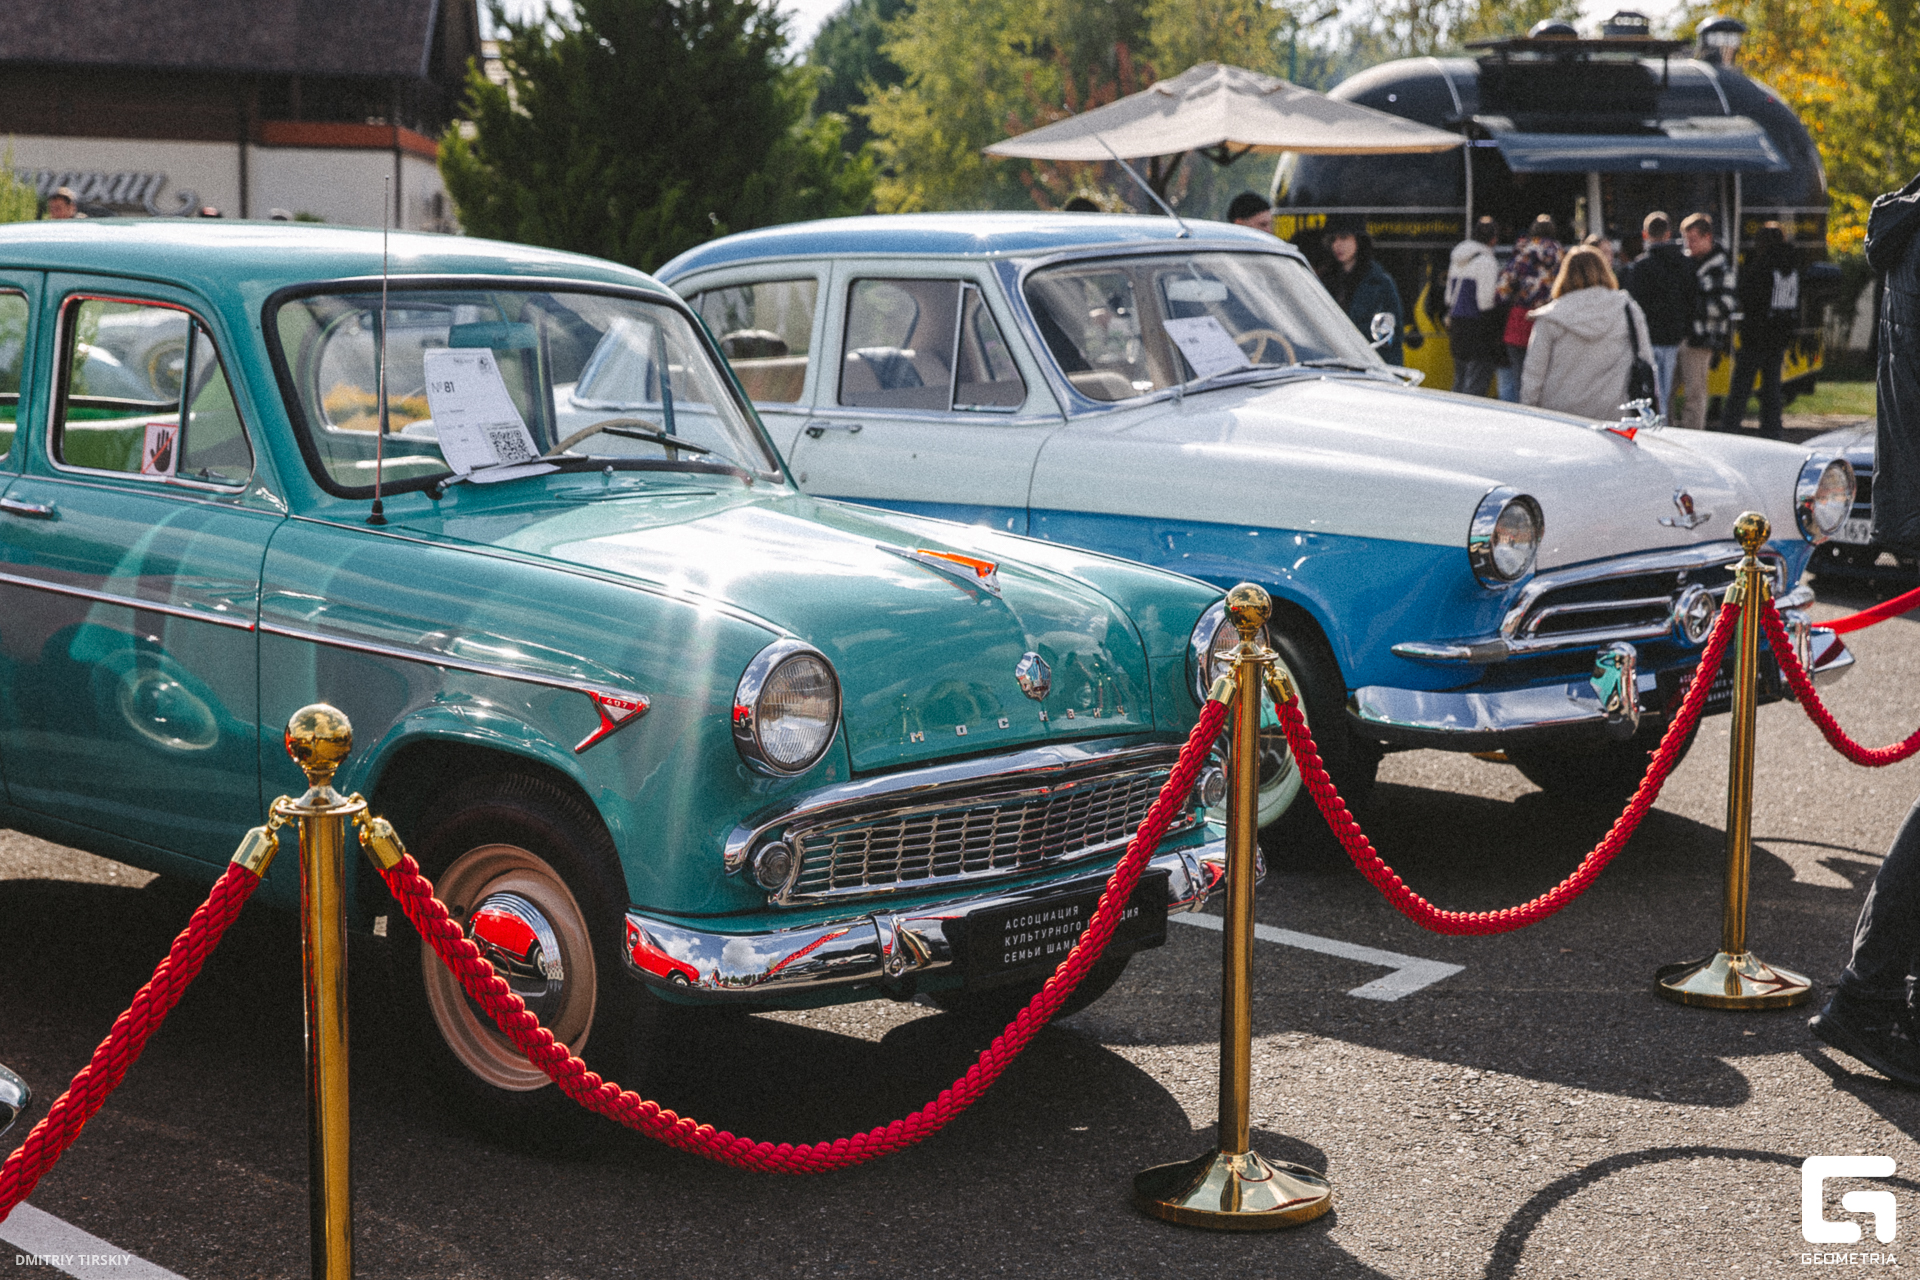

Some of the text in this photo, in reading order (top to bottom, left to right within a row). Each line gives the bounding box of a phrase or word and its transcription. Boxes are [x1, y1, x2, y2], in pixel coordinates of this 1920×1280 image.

[606, 698, 629, 709] 407
[1005, 905, 1079, 930] АССОЦИАЦИЯ
[1004, 921, 1082, 947] КУЛЬТУРНОГО
[1004, 938, 1077, 963] СЕМЬИ ШАМА
